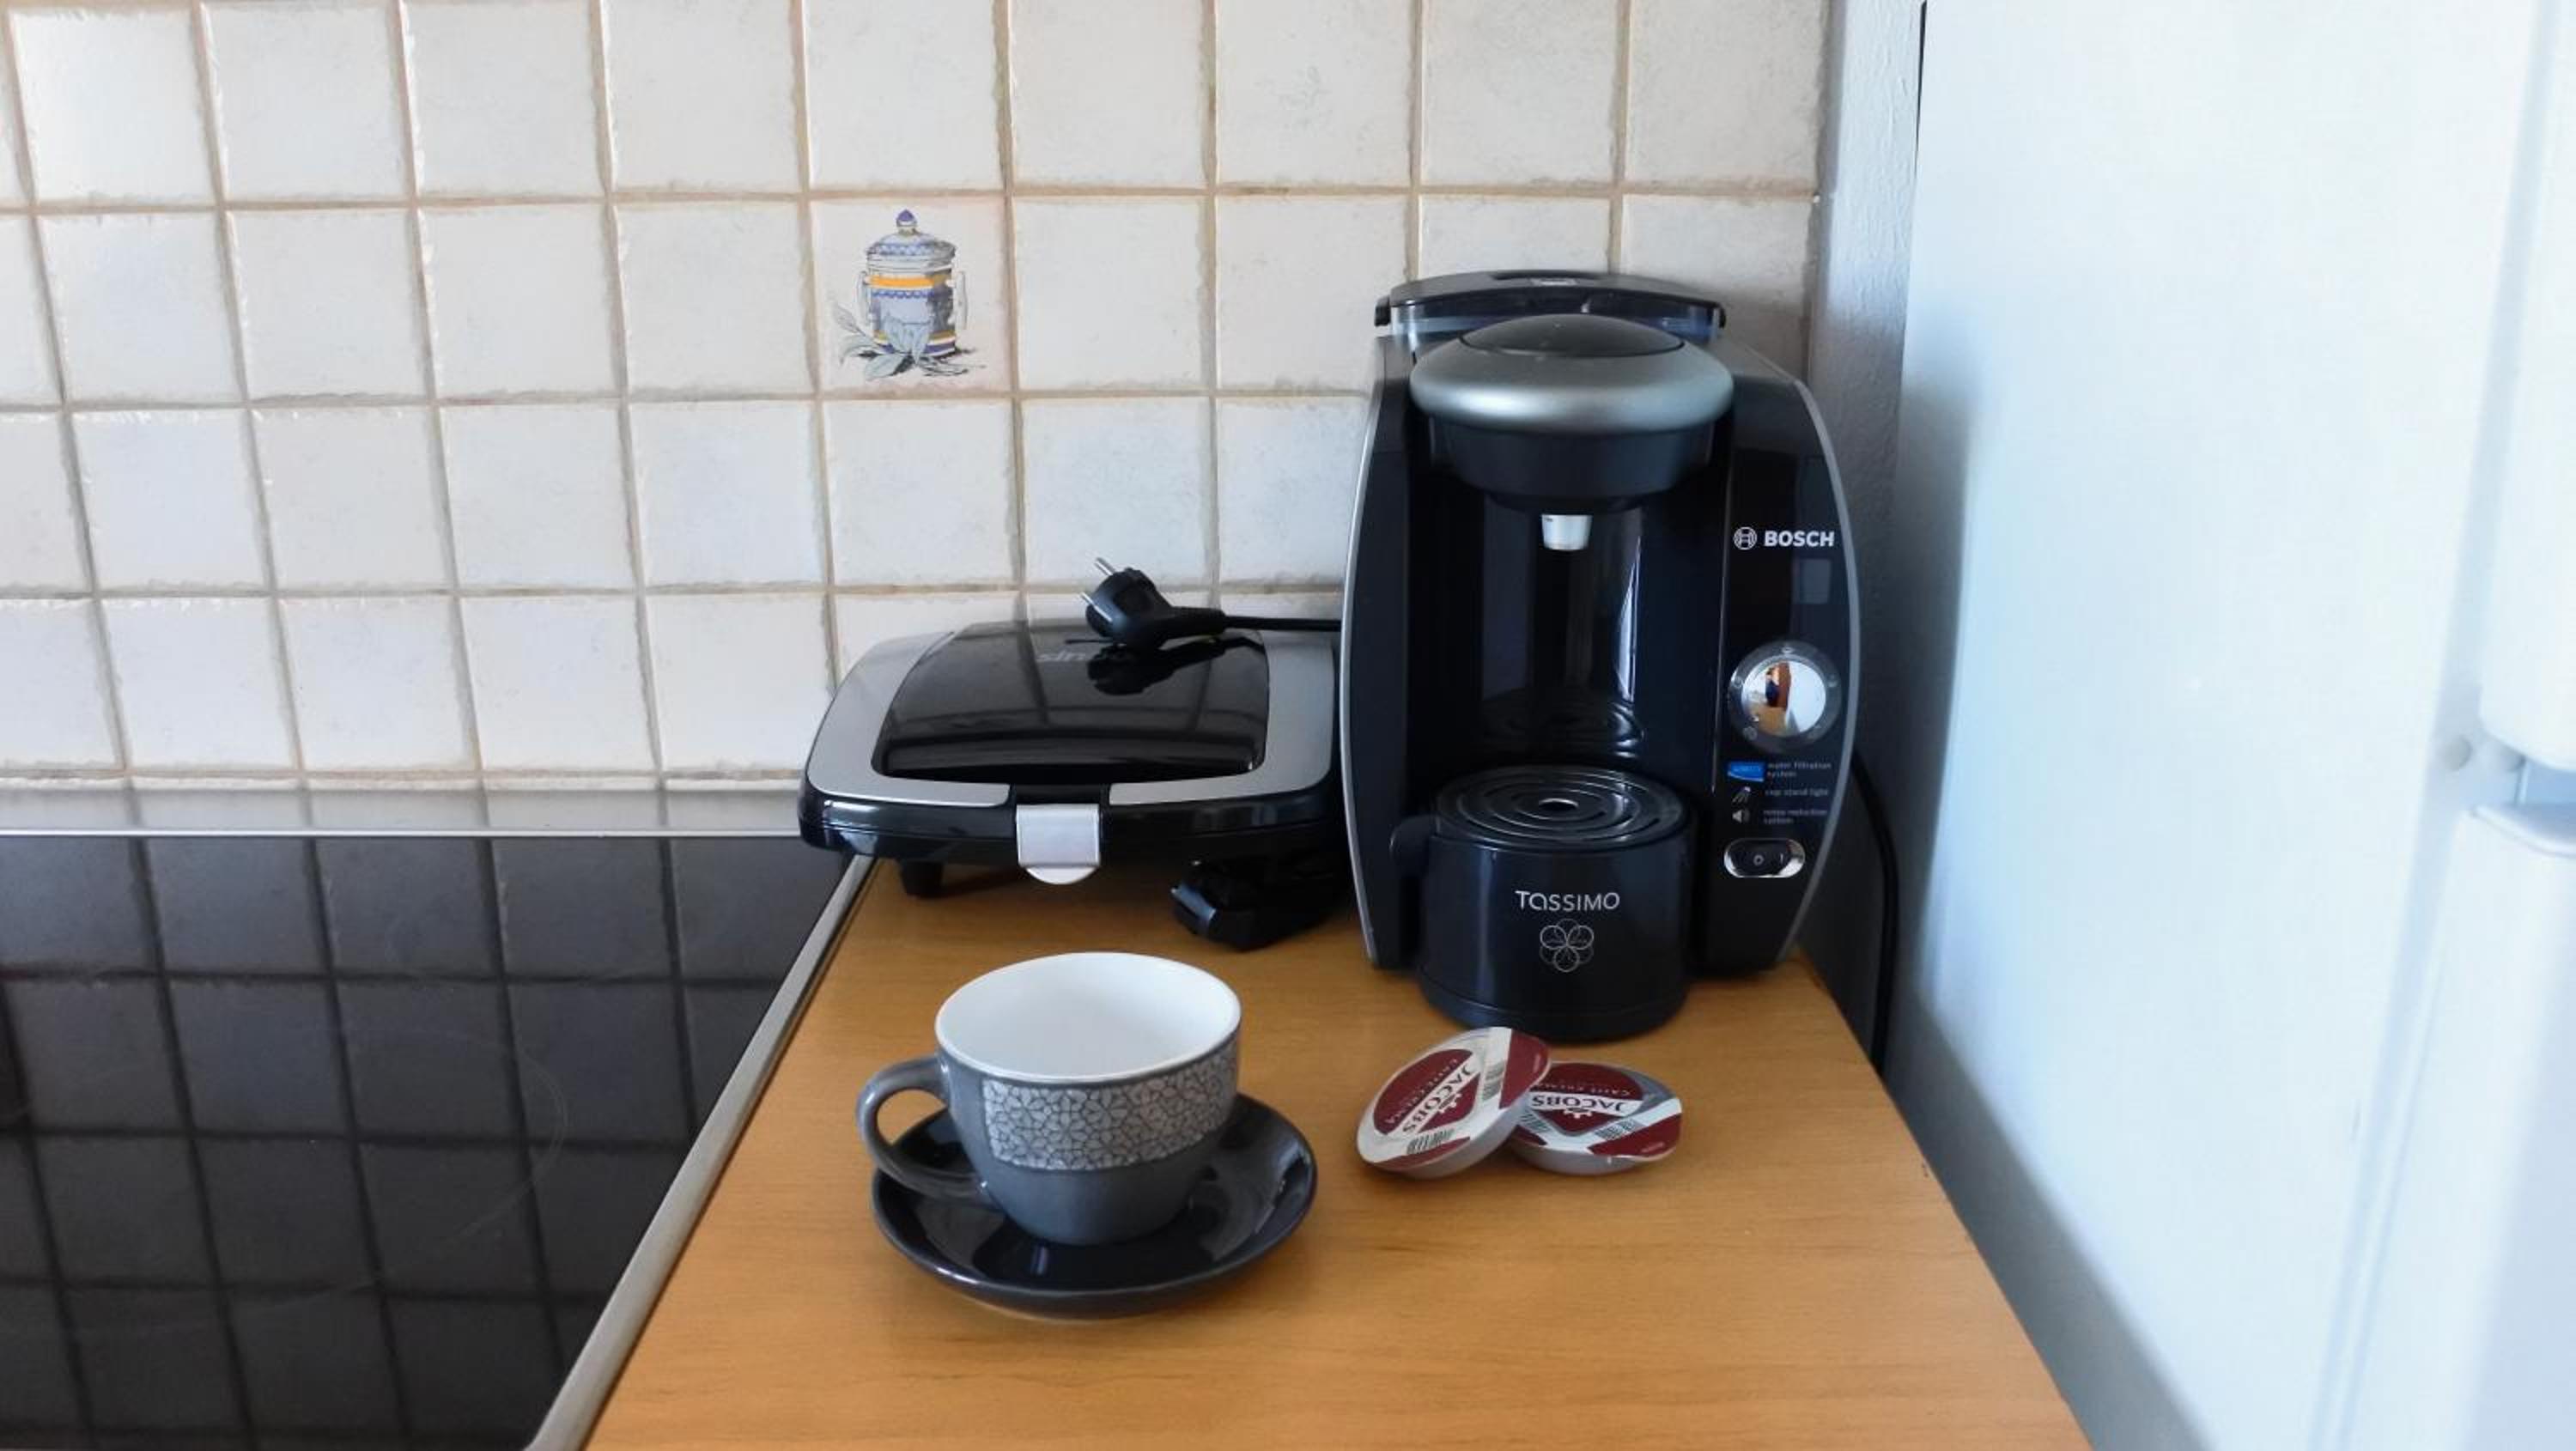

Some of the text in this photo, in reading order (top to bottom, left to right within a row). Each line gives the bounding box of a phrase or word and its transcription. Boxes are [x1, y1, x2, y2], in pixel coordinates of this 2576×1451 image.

[1763, 530, 1835, 547] BOSCH
[1402, 1063, 1472, 1132] JACOBS
[1531, 1095, 1625, 1112] JACOBS
